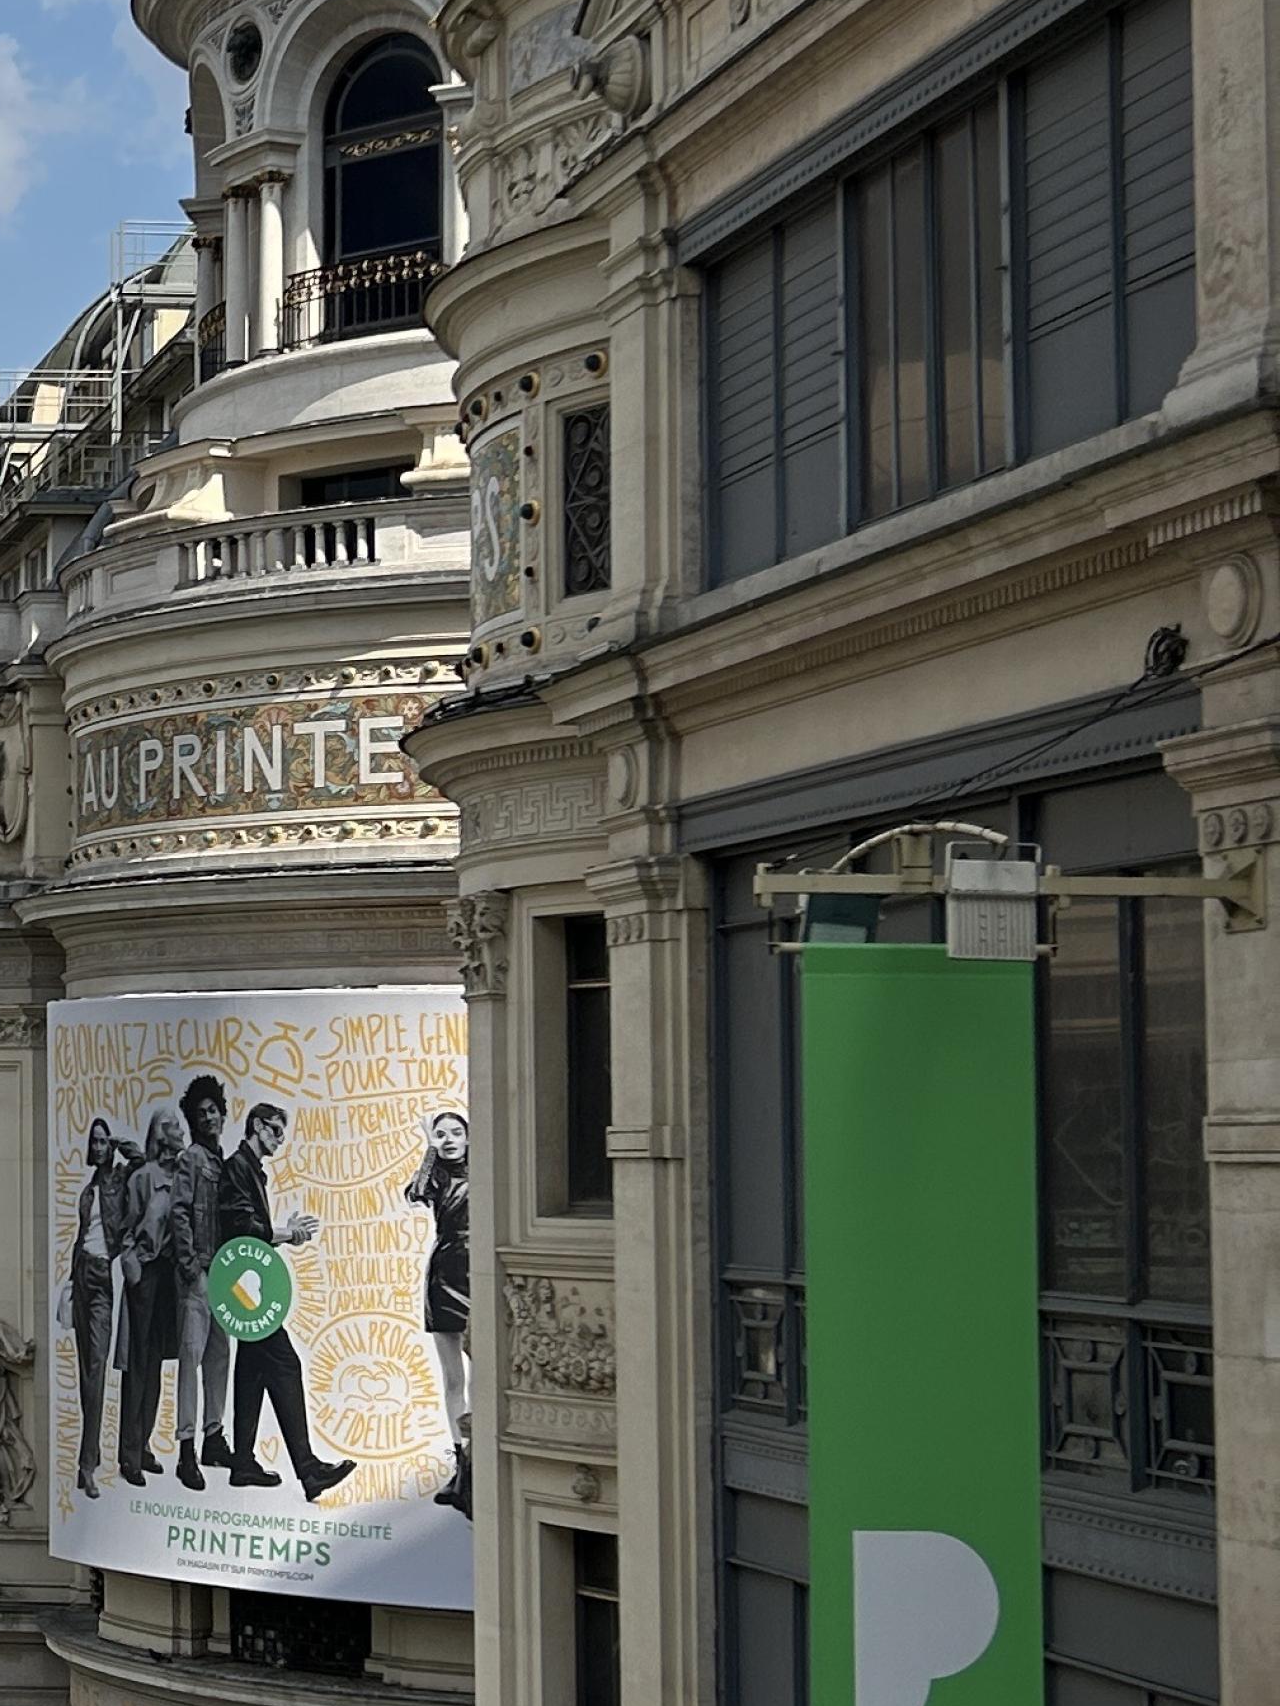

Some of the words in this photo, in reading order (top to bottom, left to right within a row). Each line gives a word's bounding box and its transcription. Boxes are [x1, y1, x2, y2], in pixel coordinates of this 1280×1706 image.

[82, 746, 120, 816] AU
[55, 1022, 149, 1084] REJOIGNEZ
[155, 1022, 175, 1056] LE
[176, 1016, 250, 1077] CLUB
[325, 1056, 396, 1099] POUR
[55, 1064, 174, 1144] PRINTEMPS
[294, 1142, 365, 1180] SERVICES
[55, 1147, 86, 1286] PRINTEMPS
[320, 1218, 413, 1255] ATTENTIONS
[220, 1249, 236, 1267] LE
[238, 1243, 272, 1267] CLUB
[216, 1301, 282, 1333] PRINTEMPS
[328, 1288, 391, 1317] CADEAUX
[56, 1336, 78, 1391] CLUB
[309, 1322, 367, 1393] NOUVEAU
[368, 1320, 439, 1411] PROGRAMME
[96, 1376, 120, 1488] ACCESSIBLE
[151, 1367, 177, 1455] CAGNOTTE
[315, 1404, 338, 1429] DE
[129, 1499, 142, 1514] LE
[144, 1502, 201, 1523] NOUVEAU
[203, 1508, 296, 1533] PROGRAMME
[299, 1519, 320, 1535] DE
[324, 1519, 393, 1541] FIDÉLITÉ
[166, 1525, 332, 1567] PRINTEMPS
